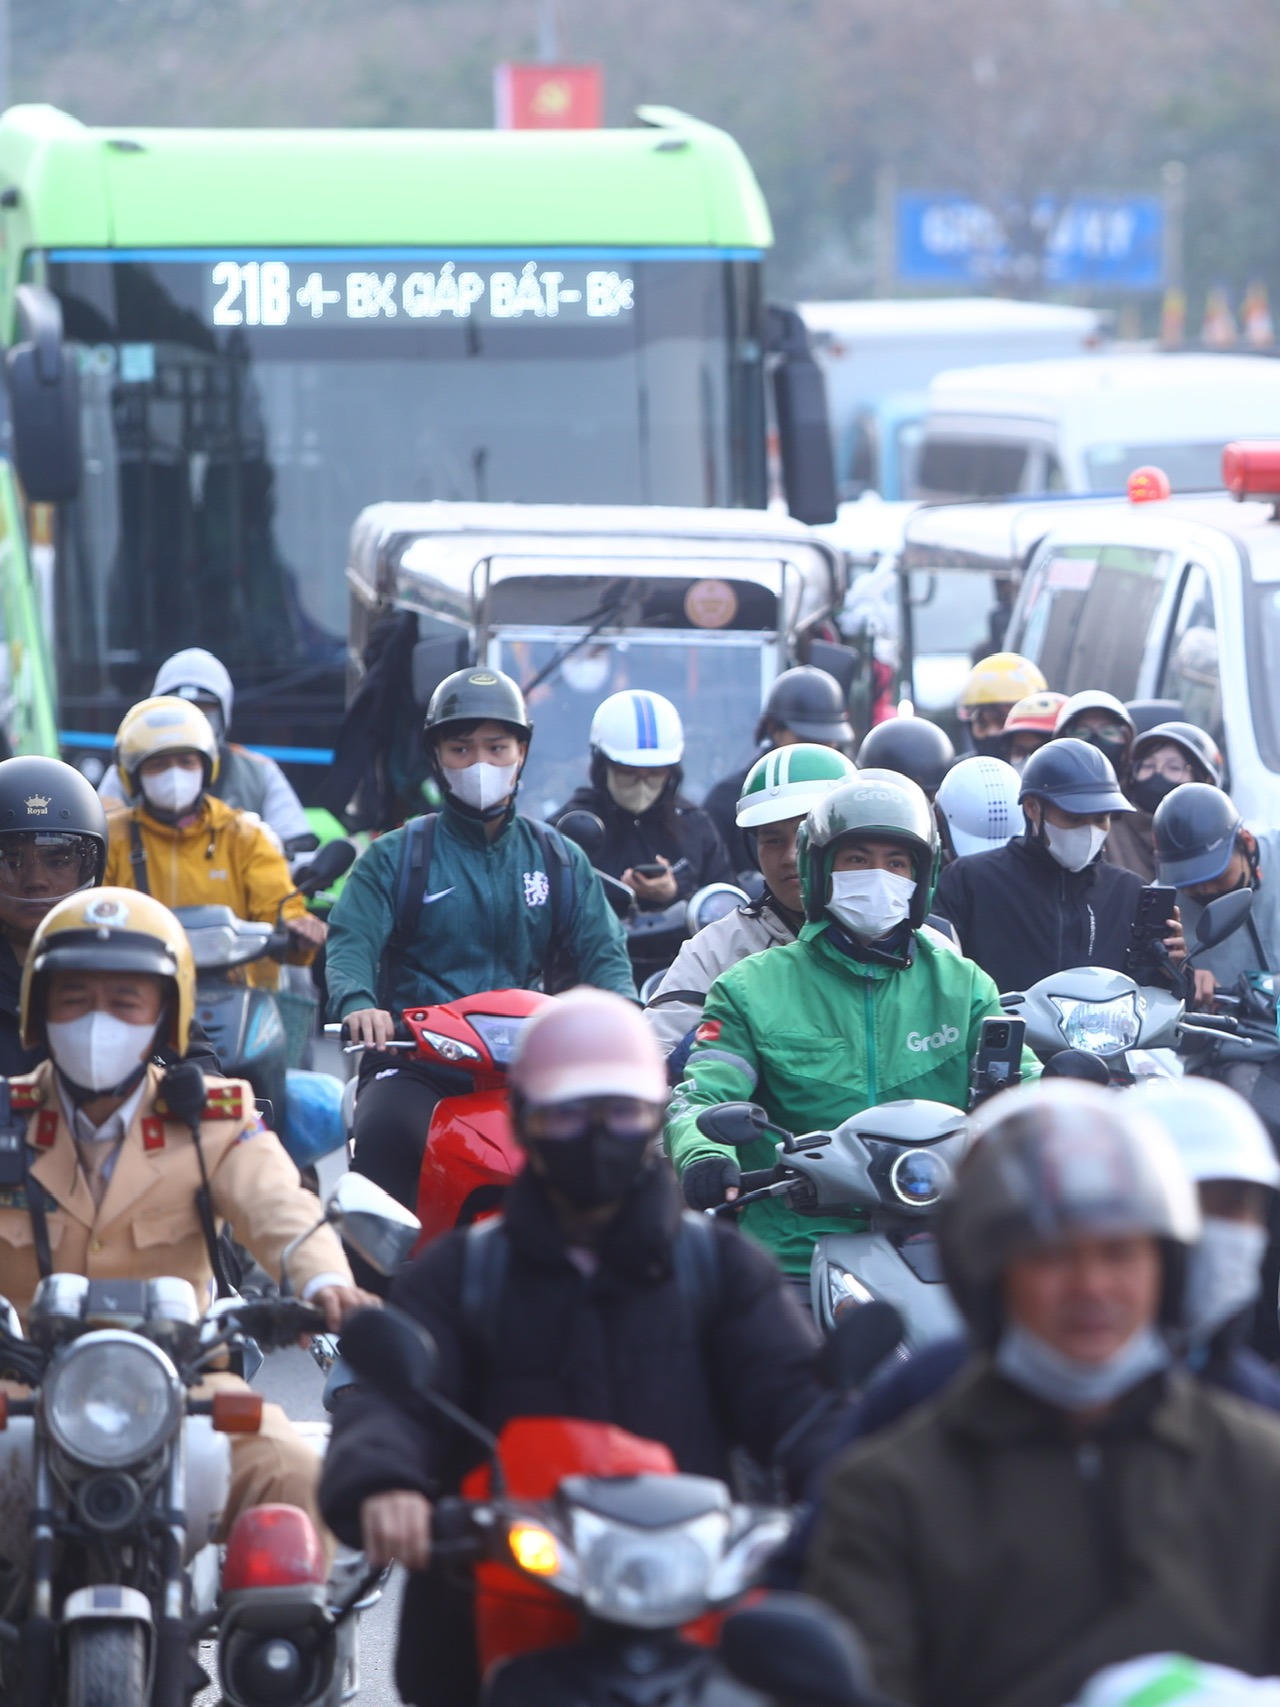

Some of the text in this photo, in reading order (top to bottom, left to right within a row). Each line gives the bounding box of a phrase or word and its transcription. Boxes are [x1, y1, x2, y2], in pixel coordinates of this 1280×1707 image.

[211, 261, 291, 326] 21B
[346, 272, 397, 318] BX
[402, 261, 485, 318] GIÁP
[26, 807, 48, 816] Royal
[906, 1023, 960, 1052] Grab
